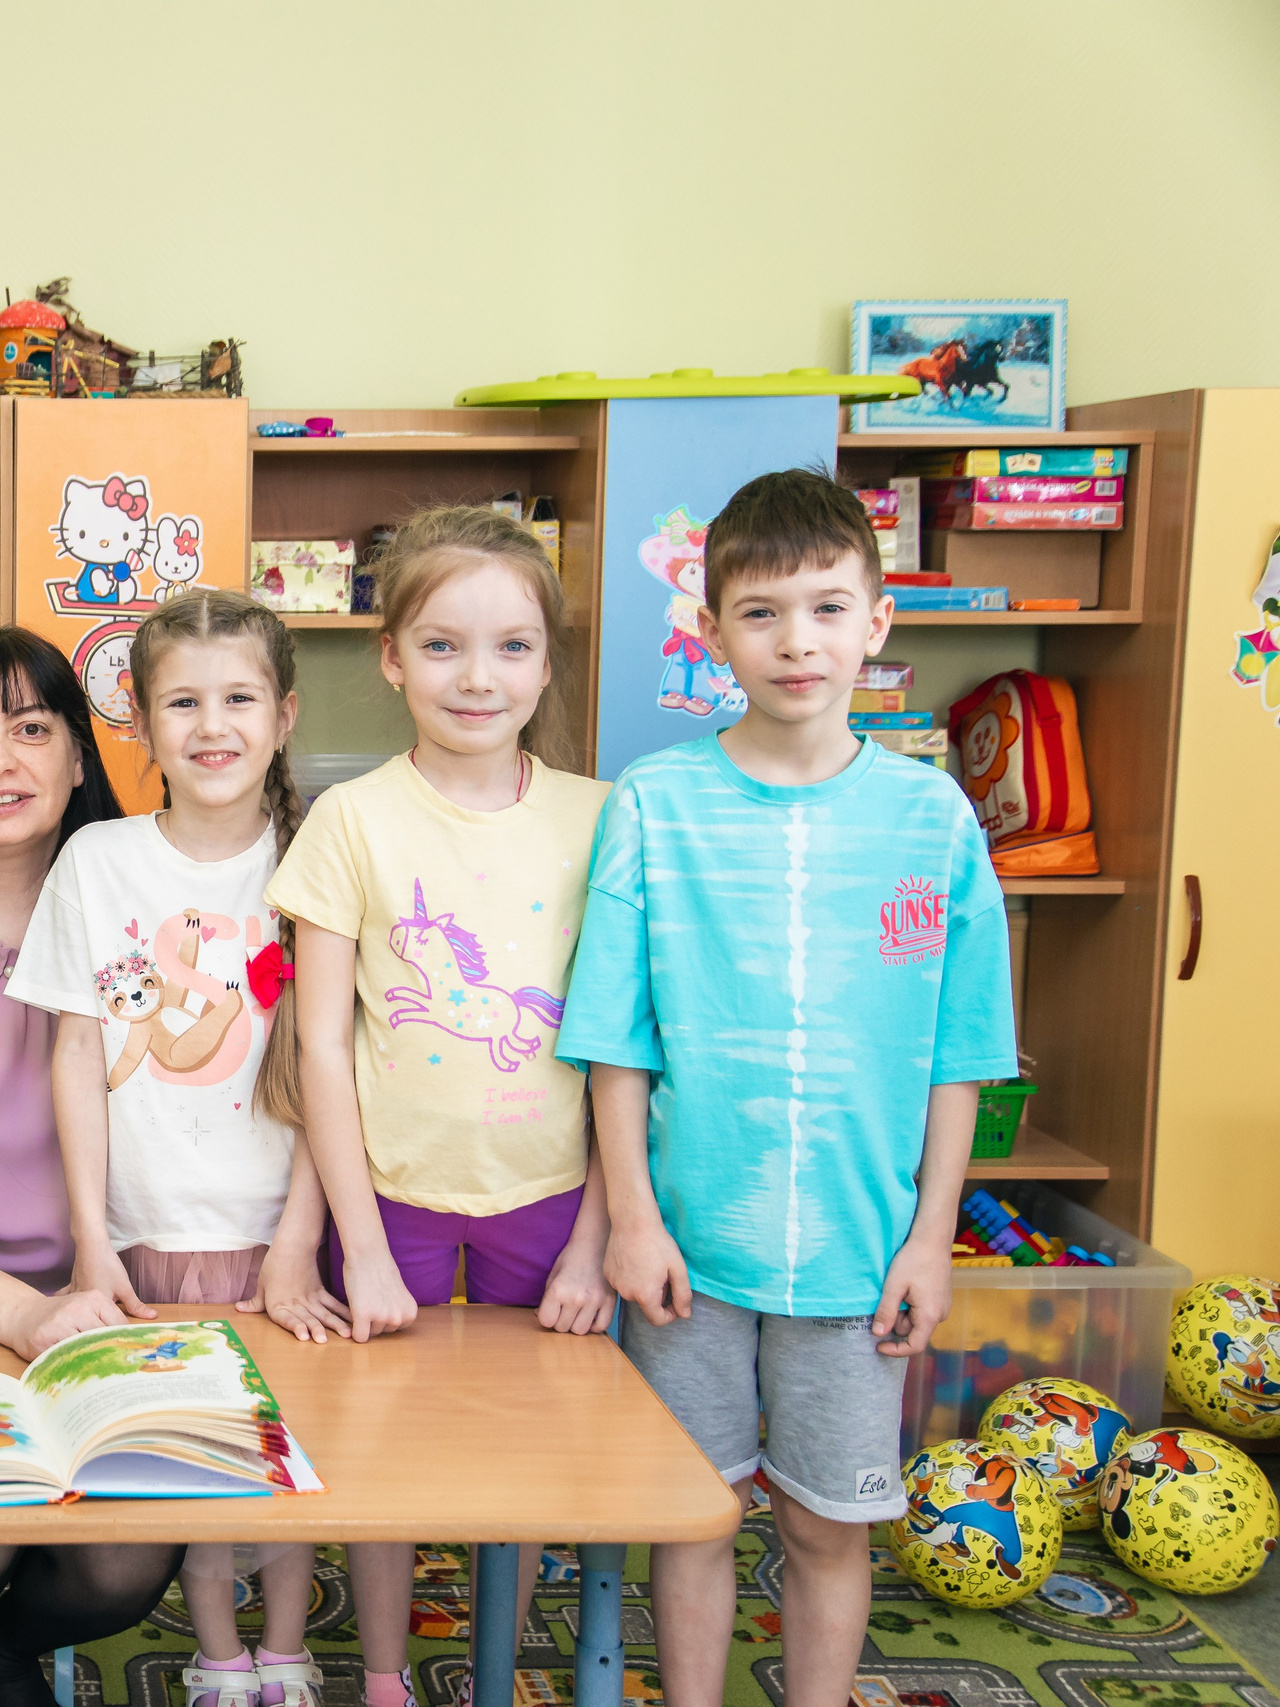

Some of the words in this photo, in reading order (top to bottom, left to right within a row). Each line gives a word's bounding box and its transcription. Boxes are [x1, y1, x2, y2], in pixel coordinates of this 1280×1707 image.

[109, 656, 125, 667] Lb
[879, 894, 949, 940] SUNSE
[882, 956, 907, 966] STATE
[912, 953, 925, 964] OF
[485, 1088, 496, 1102] I
[501, 1087, 547, 1102] believe
[481, 1110, 493, 1125] I
[812, 1319, 828, 1327] YOU
[829, 1322, 845, 1330] ARE
[859, 1473, 887, 1494] Este
